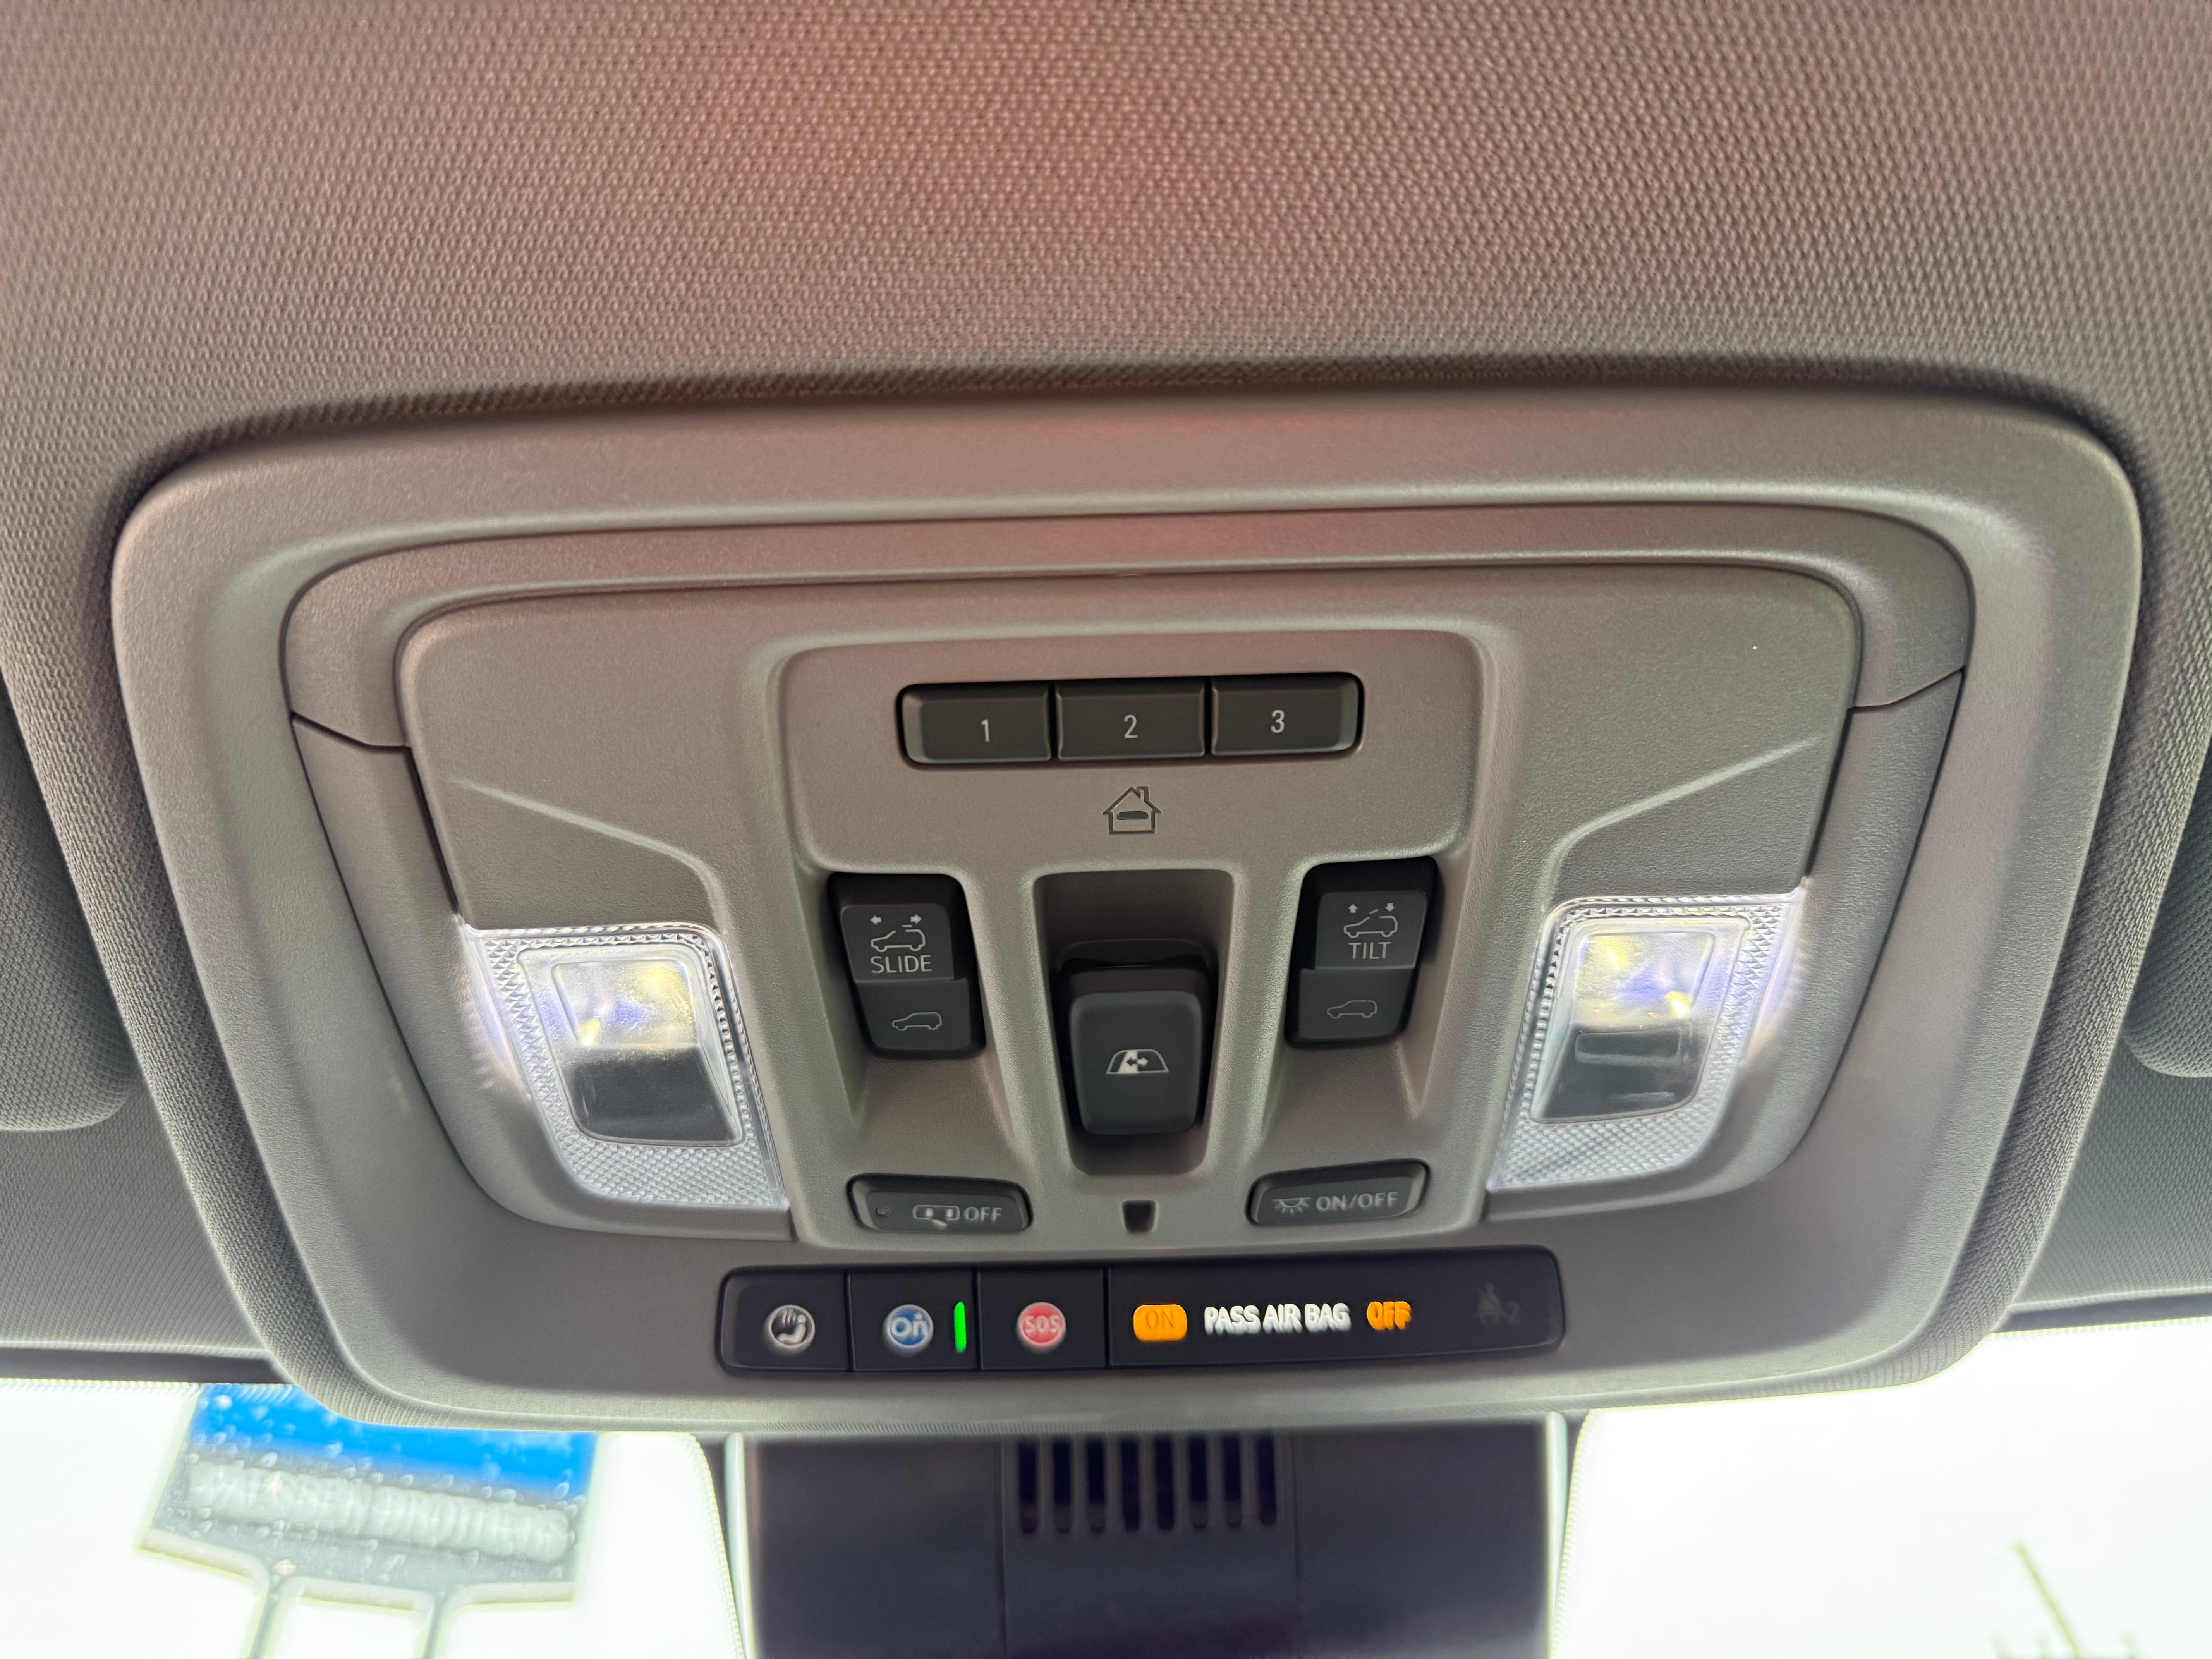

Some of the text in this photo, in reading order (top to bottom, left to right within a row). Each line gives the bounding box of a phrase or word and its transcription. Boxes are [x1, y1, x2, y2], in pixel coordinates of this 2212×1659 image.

[980, 718, 990, 742] 1
[1123, 714, 1138, 739] 2
[1270, 709, 1285, 733] 3
[1348, 941, 1391, 960] TILT
[870, 955, 933, 973] SLIDE
[1316, 1192, 1399, 1211] ON/OFF
[964, 1206, 1003, 1222] OFF
[1024, 1314, 1060, 1334] SOS
[1144, 1300, 1412, 1336] ON PASS AIR BAG OFF
